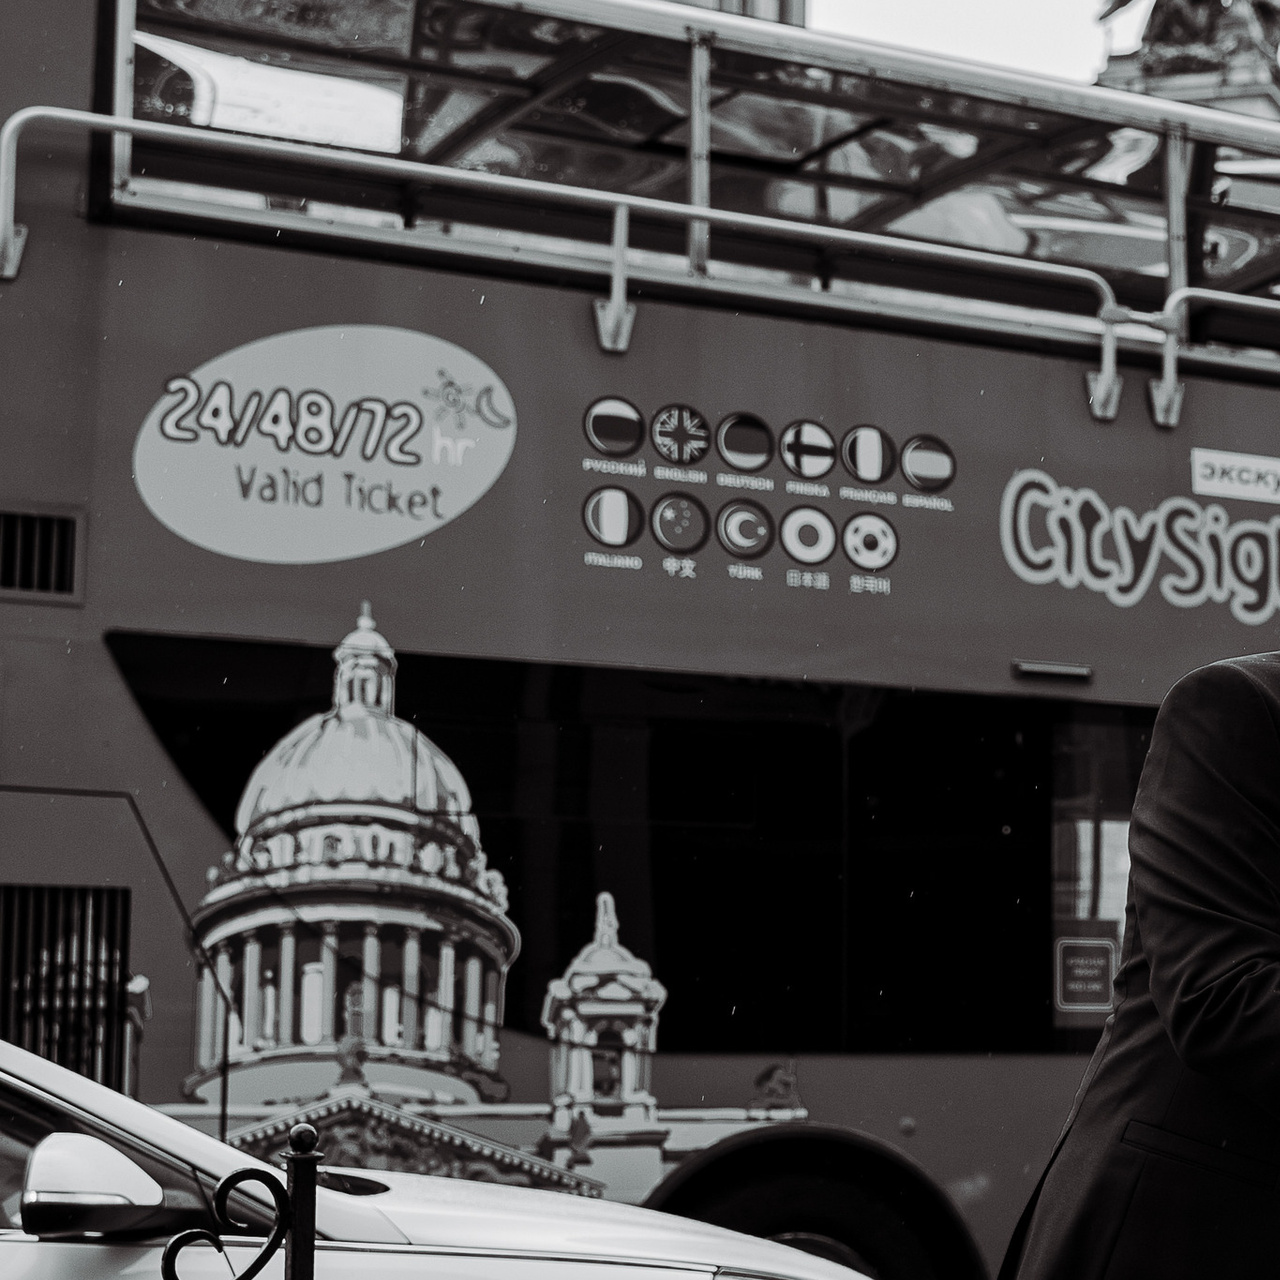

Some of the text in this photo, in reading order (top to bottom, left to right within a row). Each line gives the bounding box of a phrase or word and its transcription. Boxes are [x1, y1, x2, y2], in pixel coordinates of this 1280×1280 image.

[160, 377, 476, 467] 24/48/72 hr
[653, 466, 708, 484] ENGLISH
[716, 473, 774, 492] DEUTSCH
[234, 464, 444, 520] Valid Ticket
[584, 552, 643, 570] ITALIANO
